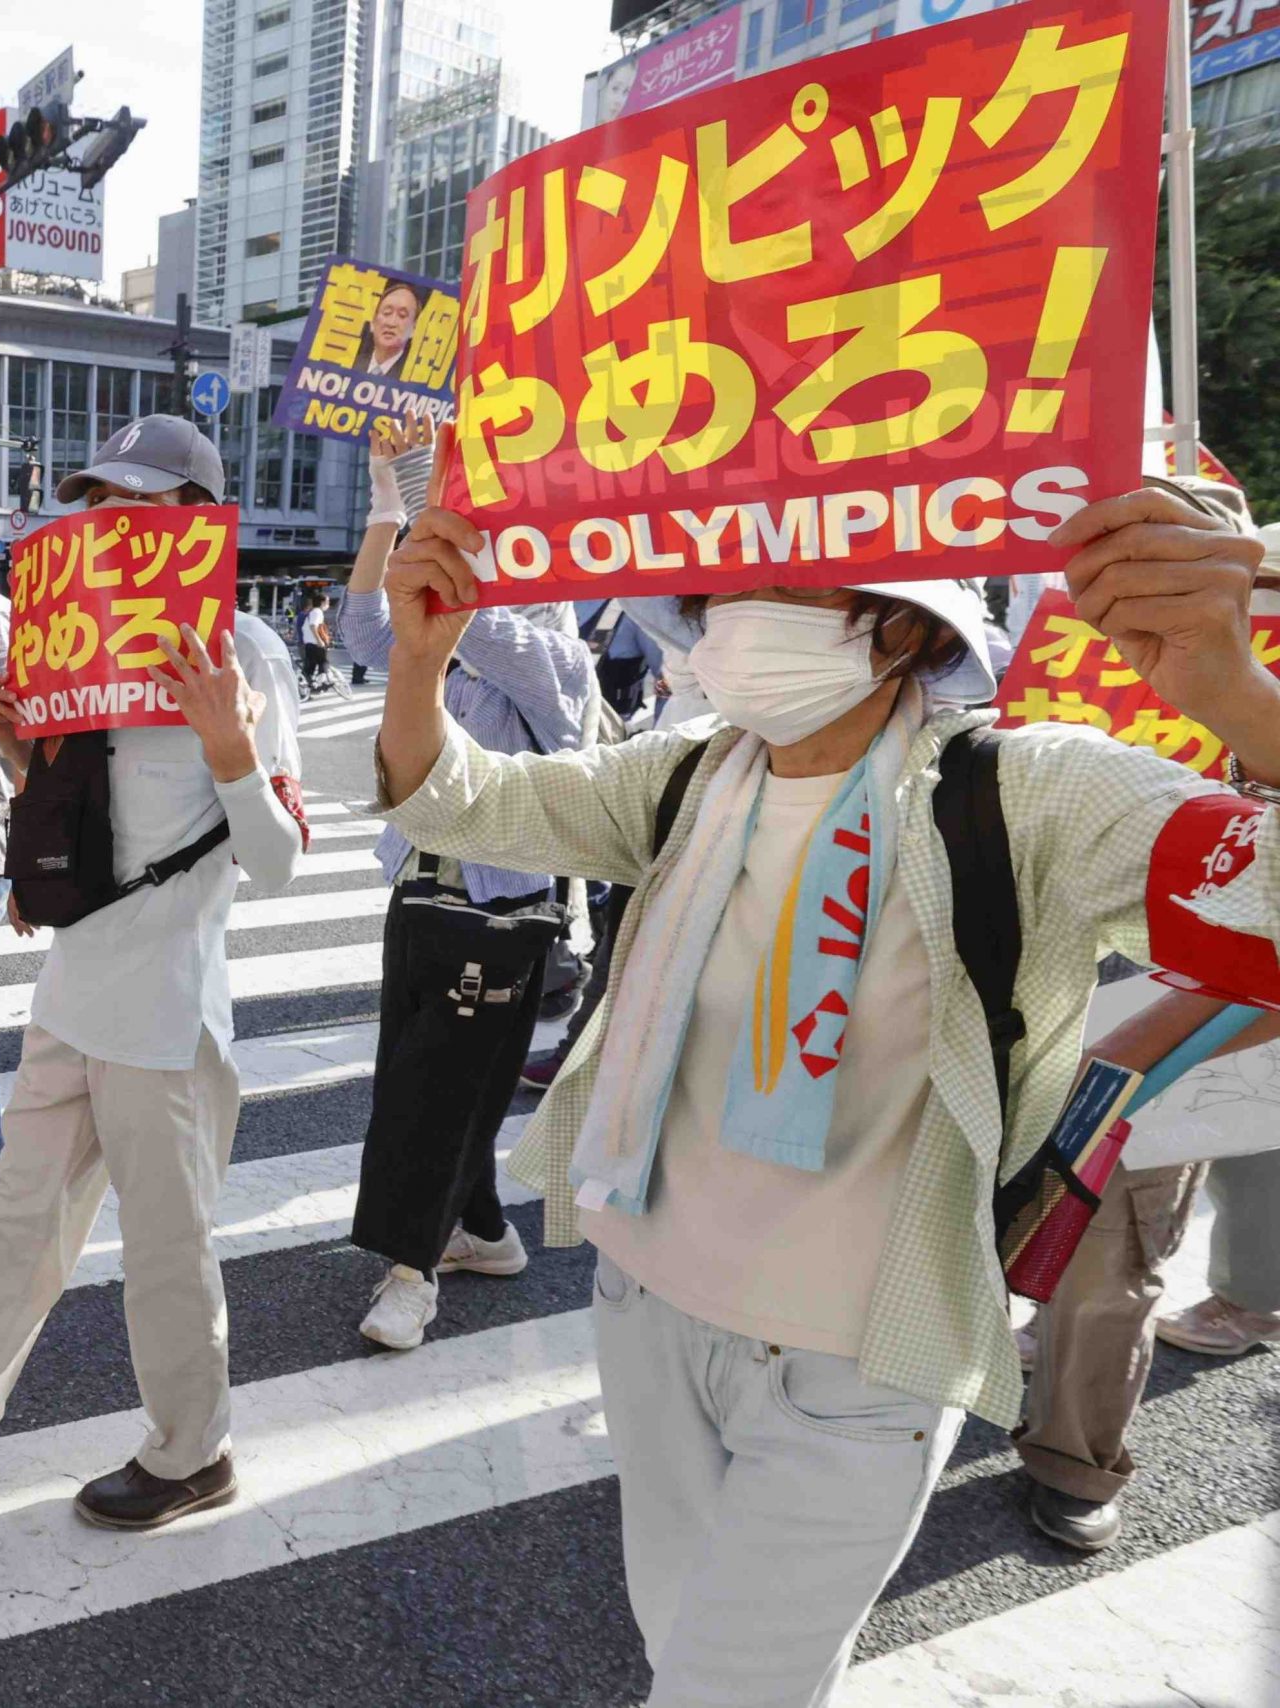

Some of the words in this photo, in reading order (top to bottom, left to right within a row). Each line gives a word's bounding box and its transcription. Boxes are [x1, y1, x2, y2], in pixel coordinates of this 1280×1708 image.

[466, 25, 1129, 347] オリンピック
[7, 218, 101, 255] JOYSOUND
[296, 366, 352, 400] NO!
[354, 380, 455, 423] OLYMPIC
[458, 246, 1109, 508] やめろ!
[304, 400, 368, 437] NO!
[569, 466, 1089, 574] OLYMPICS
[14, 515, 228, 614] オリンピック
[50, 681, 183, 719] OLYMPIC
